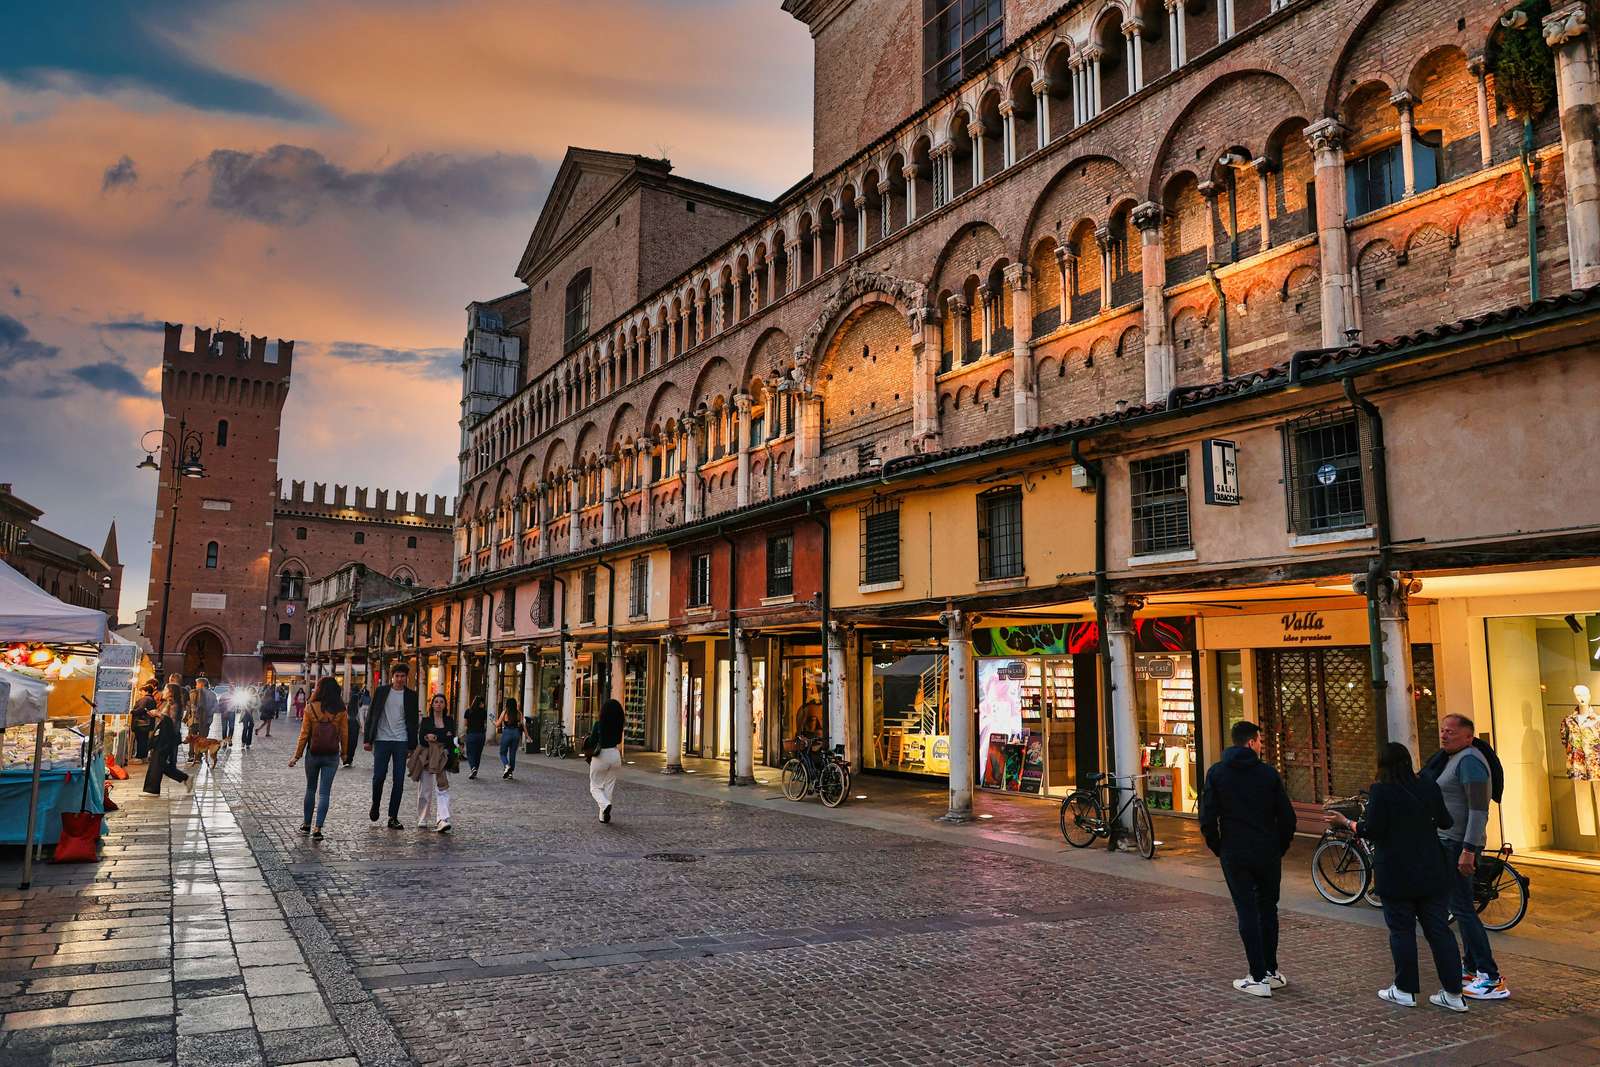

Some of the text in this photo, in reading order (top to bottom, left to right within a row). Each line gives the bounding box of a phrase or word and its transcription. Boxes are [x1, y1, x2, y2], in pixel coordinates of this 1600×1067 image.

[1213, 441, 1234, 485] T
[1216, 484, 1232, 493] SALI
[1281, 611, 1325, 631] Valla
